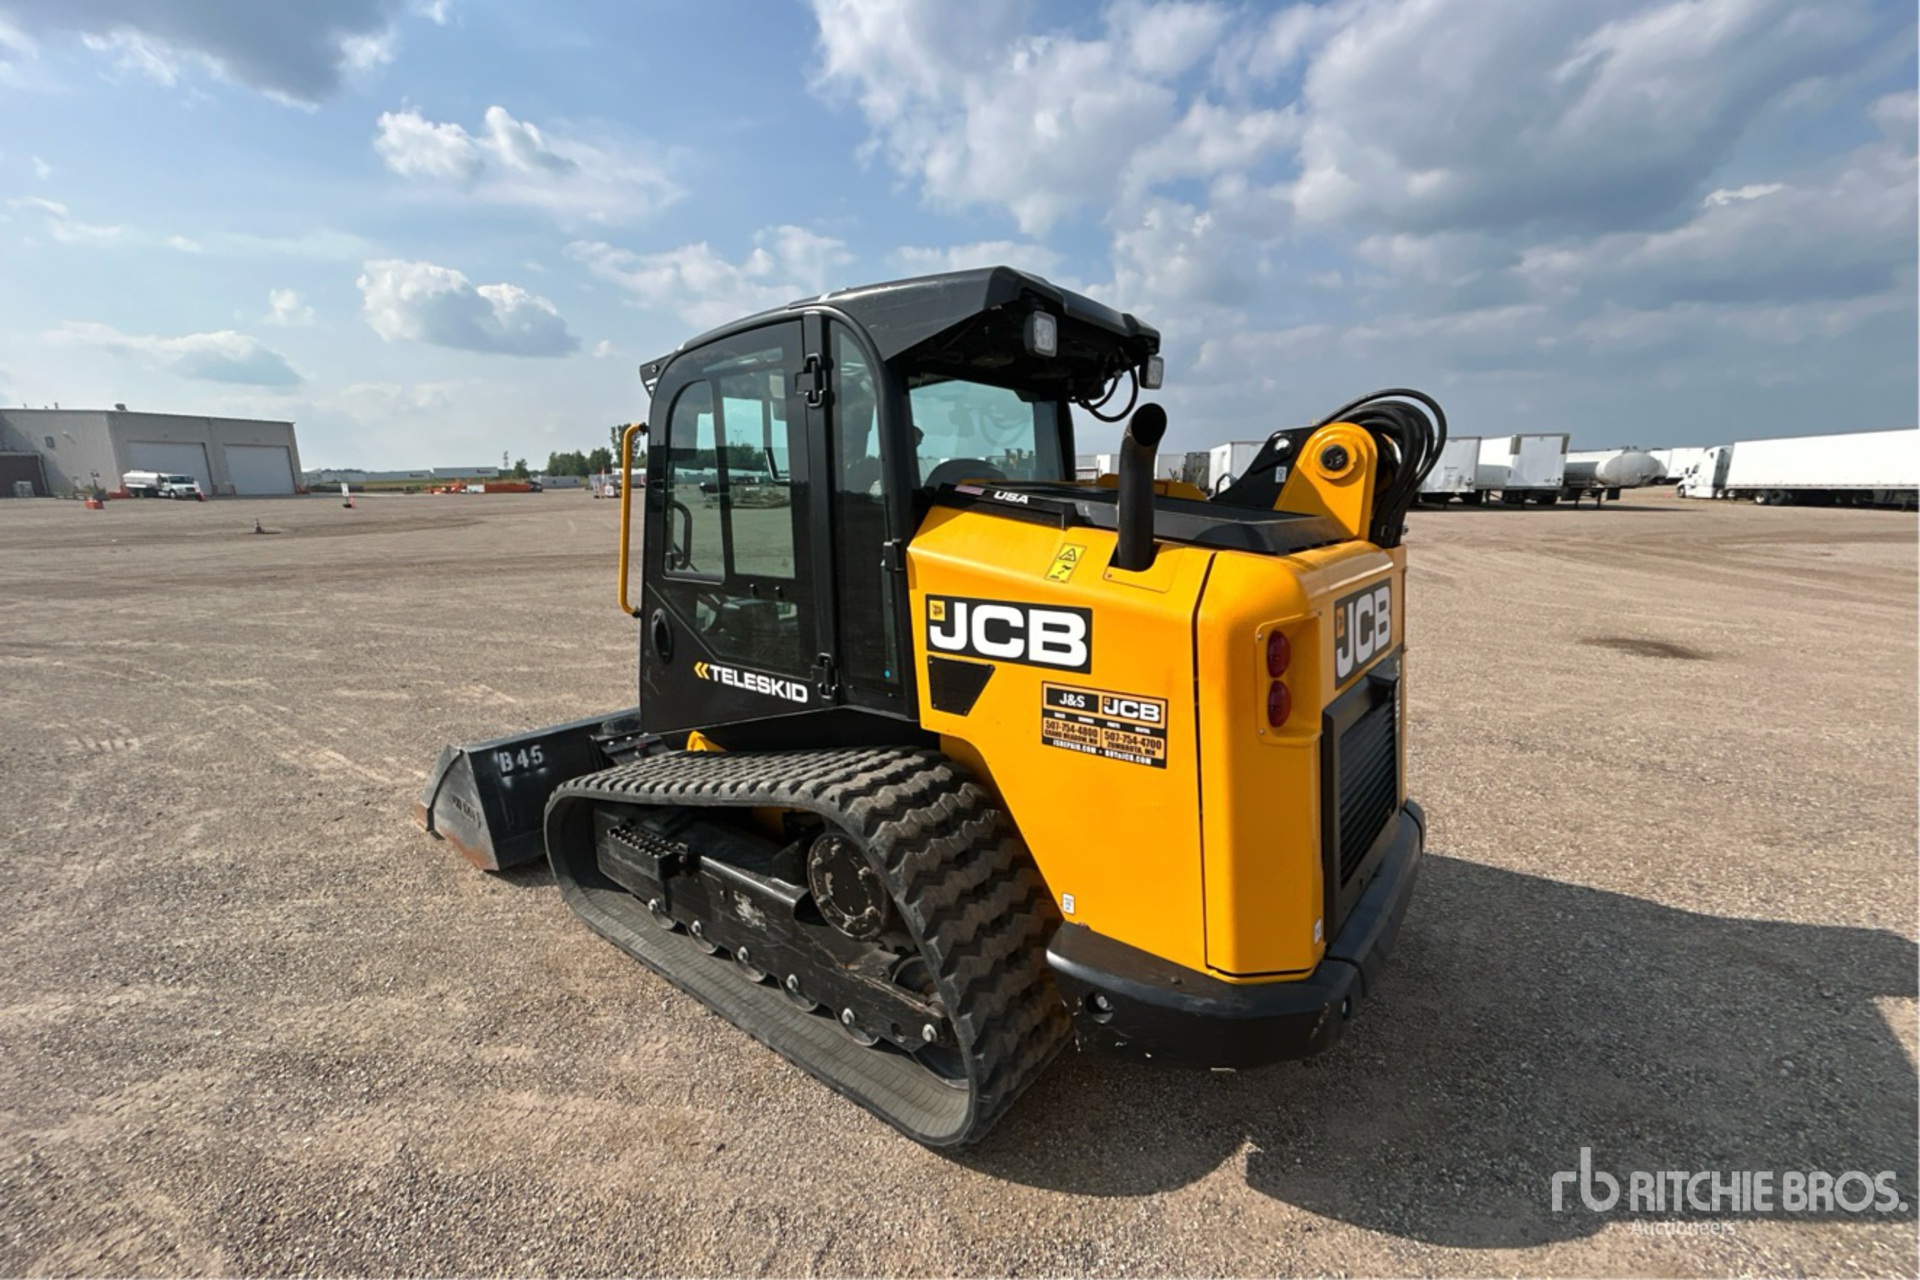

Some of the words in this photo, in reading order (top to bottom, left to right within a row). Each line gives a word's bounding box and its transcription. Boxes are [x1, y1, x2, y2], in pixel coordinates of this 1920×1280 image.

[993, 490, 1029, 505] USA
[929, 601, 1087, 667] JCB
[1336, 585, 1391, 678] JCB
[709, 664, 809, 703] TELESKID
[1059, 693, 1085, 708] J&S
[1103, 698, 1160, 722] JCB
[1104, 730, 1162, 750] 507-754-4700
